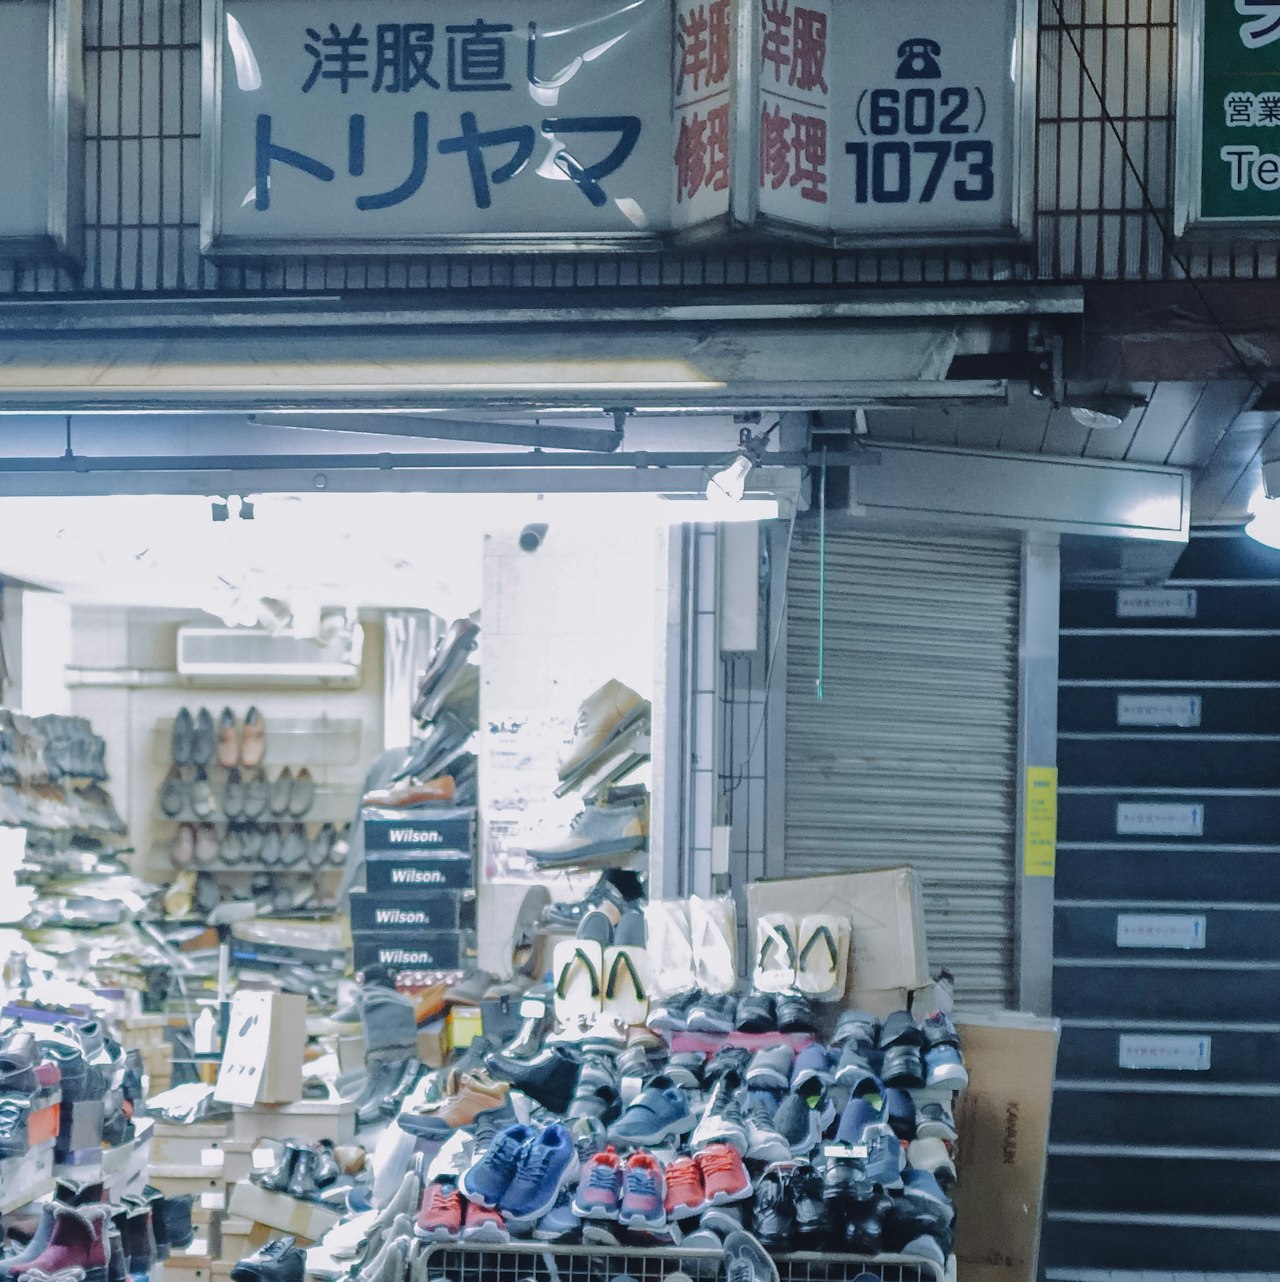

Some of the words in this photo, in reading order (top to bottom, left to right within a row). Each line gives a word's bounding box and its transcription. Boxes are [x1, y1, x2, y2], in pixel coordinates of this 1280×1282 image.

[855, 86, 986, 136] (602)
[255, 110, 642, 212] トリヤマ
[844, 140, 996, 205] 1073
[389, 828, 439, 843] Wilson
[391, 868, 441, 883] Wilson
[375, 909, 425, 924] Wilson
[378, 949, 429, 964] Wilson
